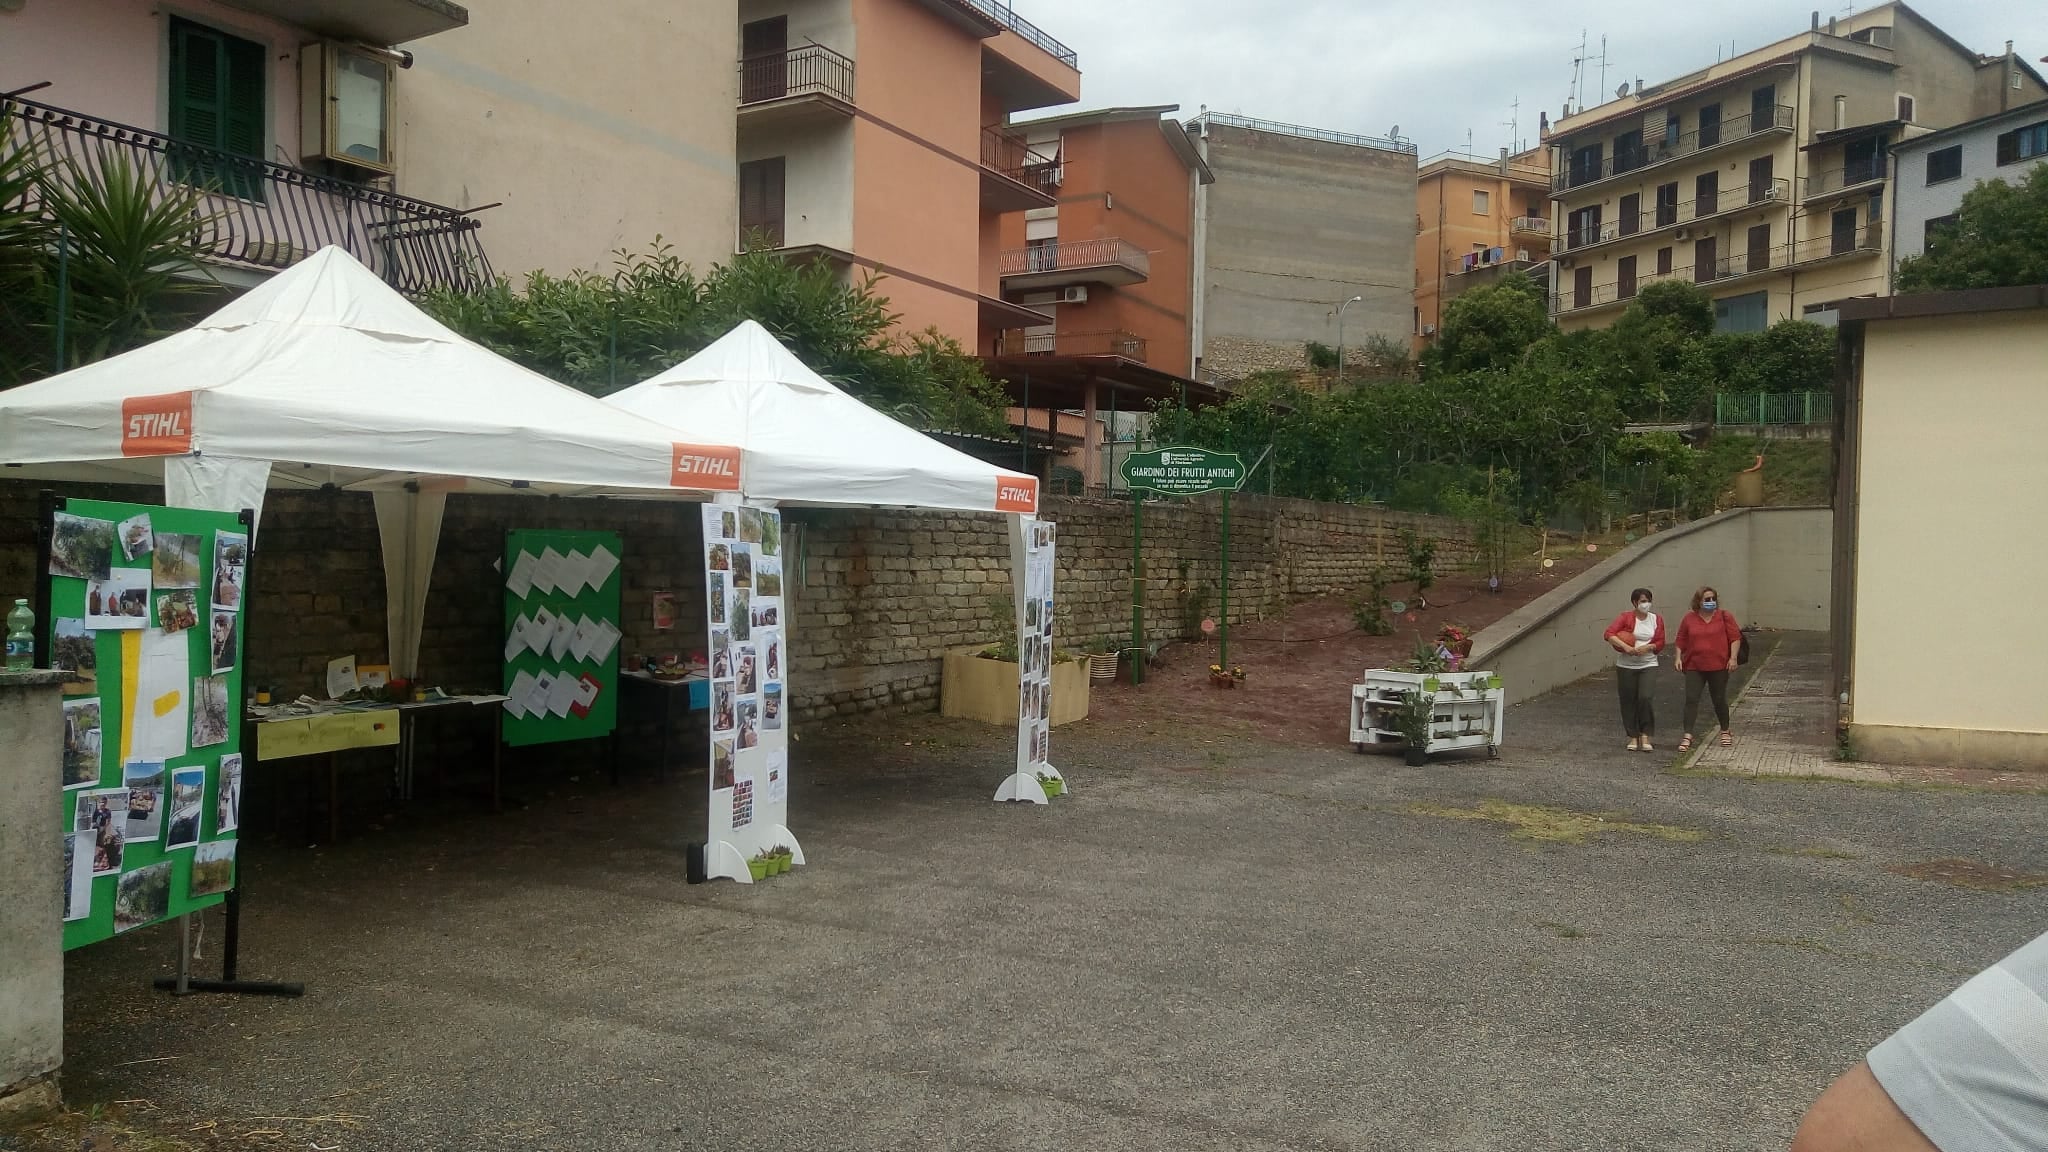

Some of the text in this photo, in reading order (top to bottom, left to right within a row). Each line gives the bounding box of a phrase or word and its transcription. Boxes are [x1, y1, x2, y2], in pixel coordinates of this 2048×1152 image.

[128, 411, 185, 438] STIHL
[678, 454, 734, 477] STIHL
[1131, 467, 1235, 478] GIARDINO DEI FRUTTI ANTICHI
[1000, 486, 1032, 503] STIHL
